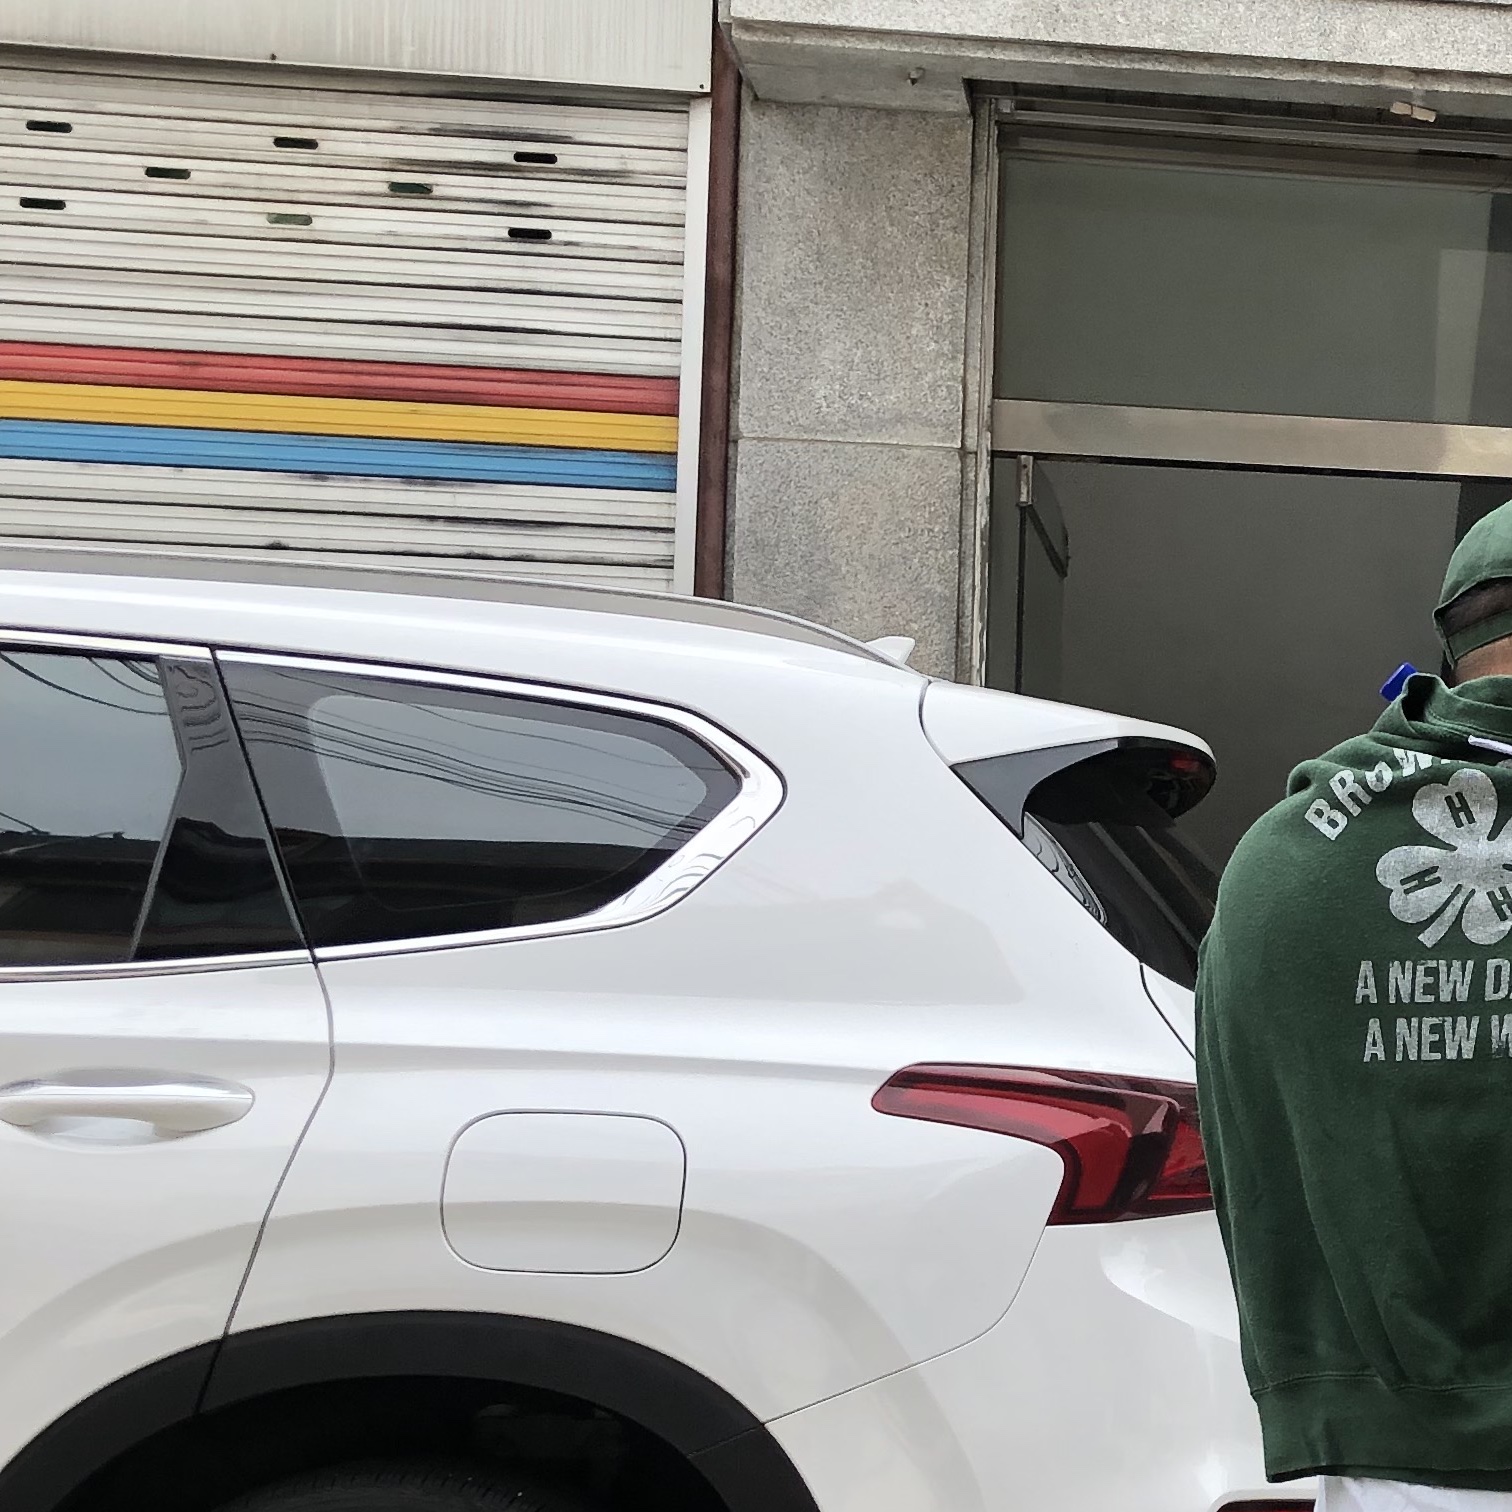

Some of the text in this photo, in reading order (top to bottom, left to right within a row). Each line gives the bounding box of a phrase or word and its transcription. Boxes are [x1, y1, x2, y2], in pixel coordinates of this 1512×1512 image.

[1304, 747, 1469, 840] BROW
[1444, 791, 1476, 828] H
[1400, 866, 1442, 894] H
[1355, 960, 1378, 1004] A
[1389, 959, 1474, 1004] NEW
[1364, 1018, 1385, 1062] A
[1395, 1015, 1479, 1061] NEW
